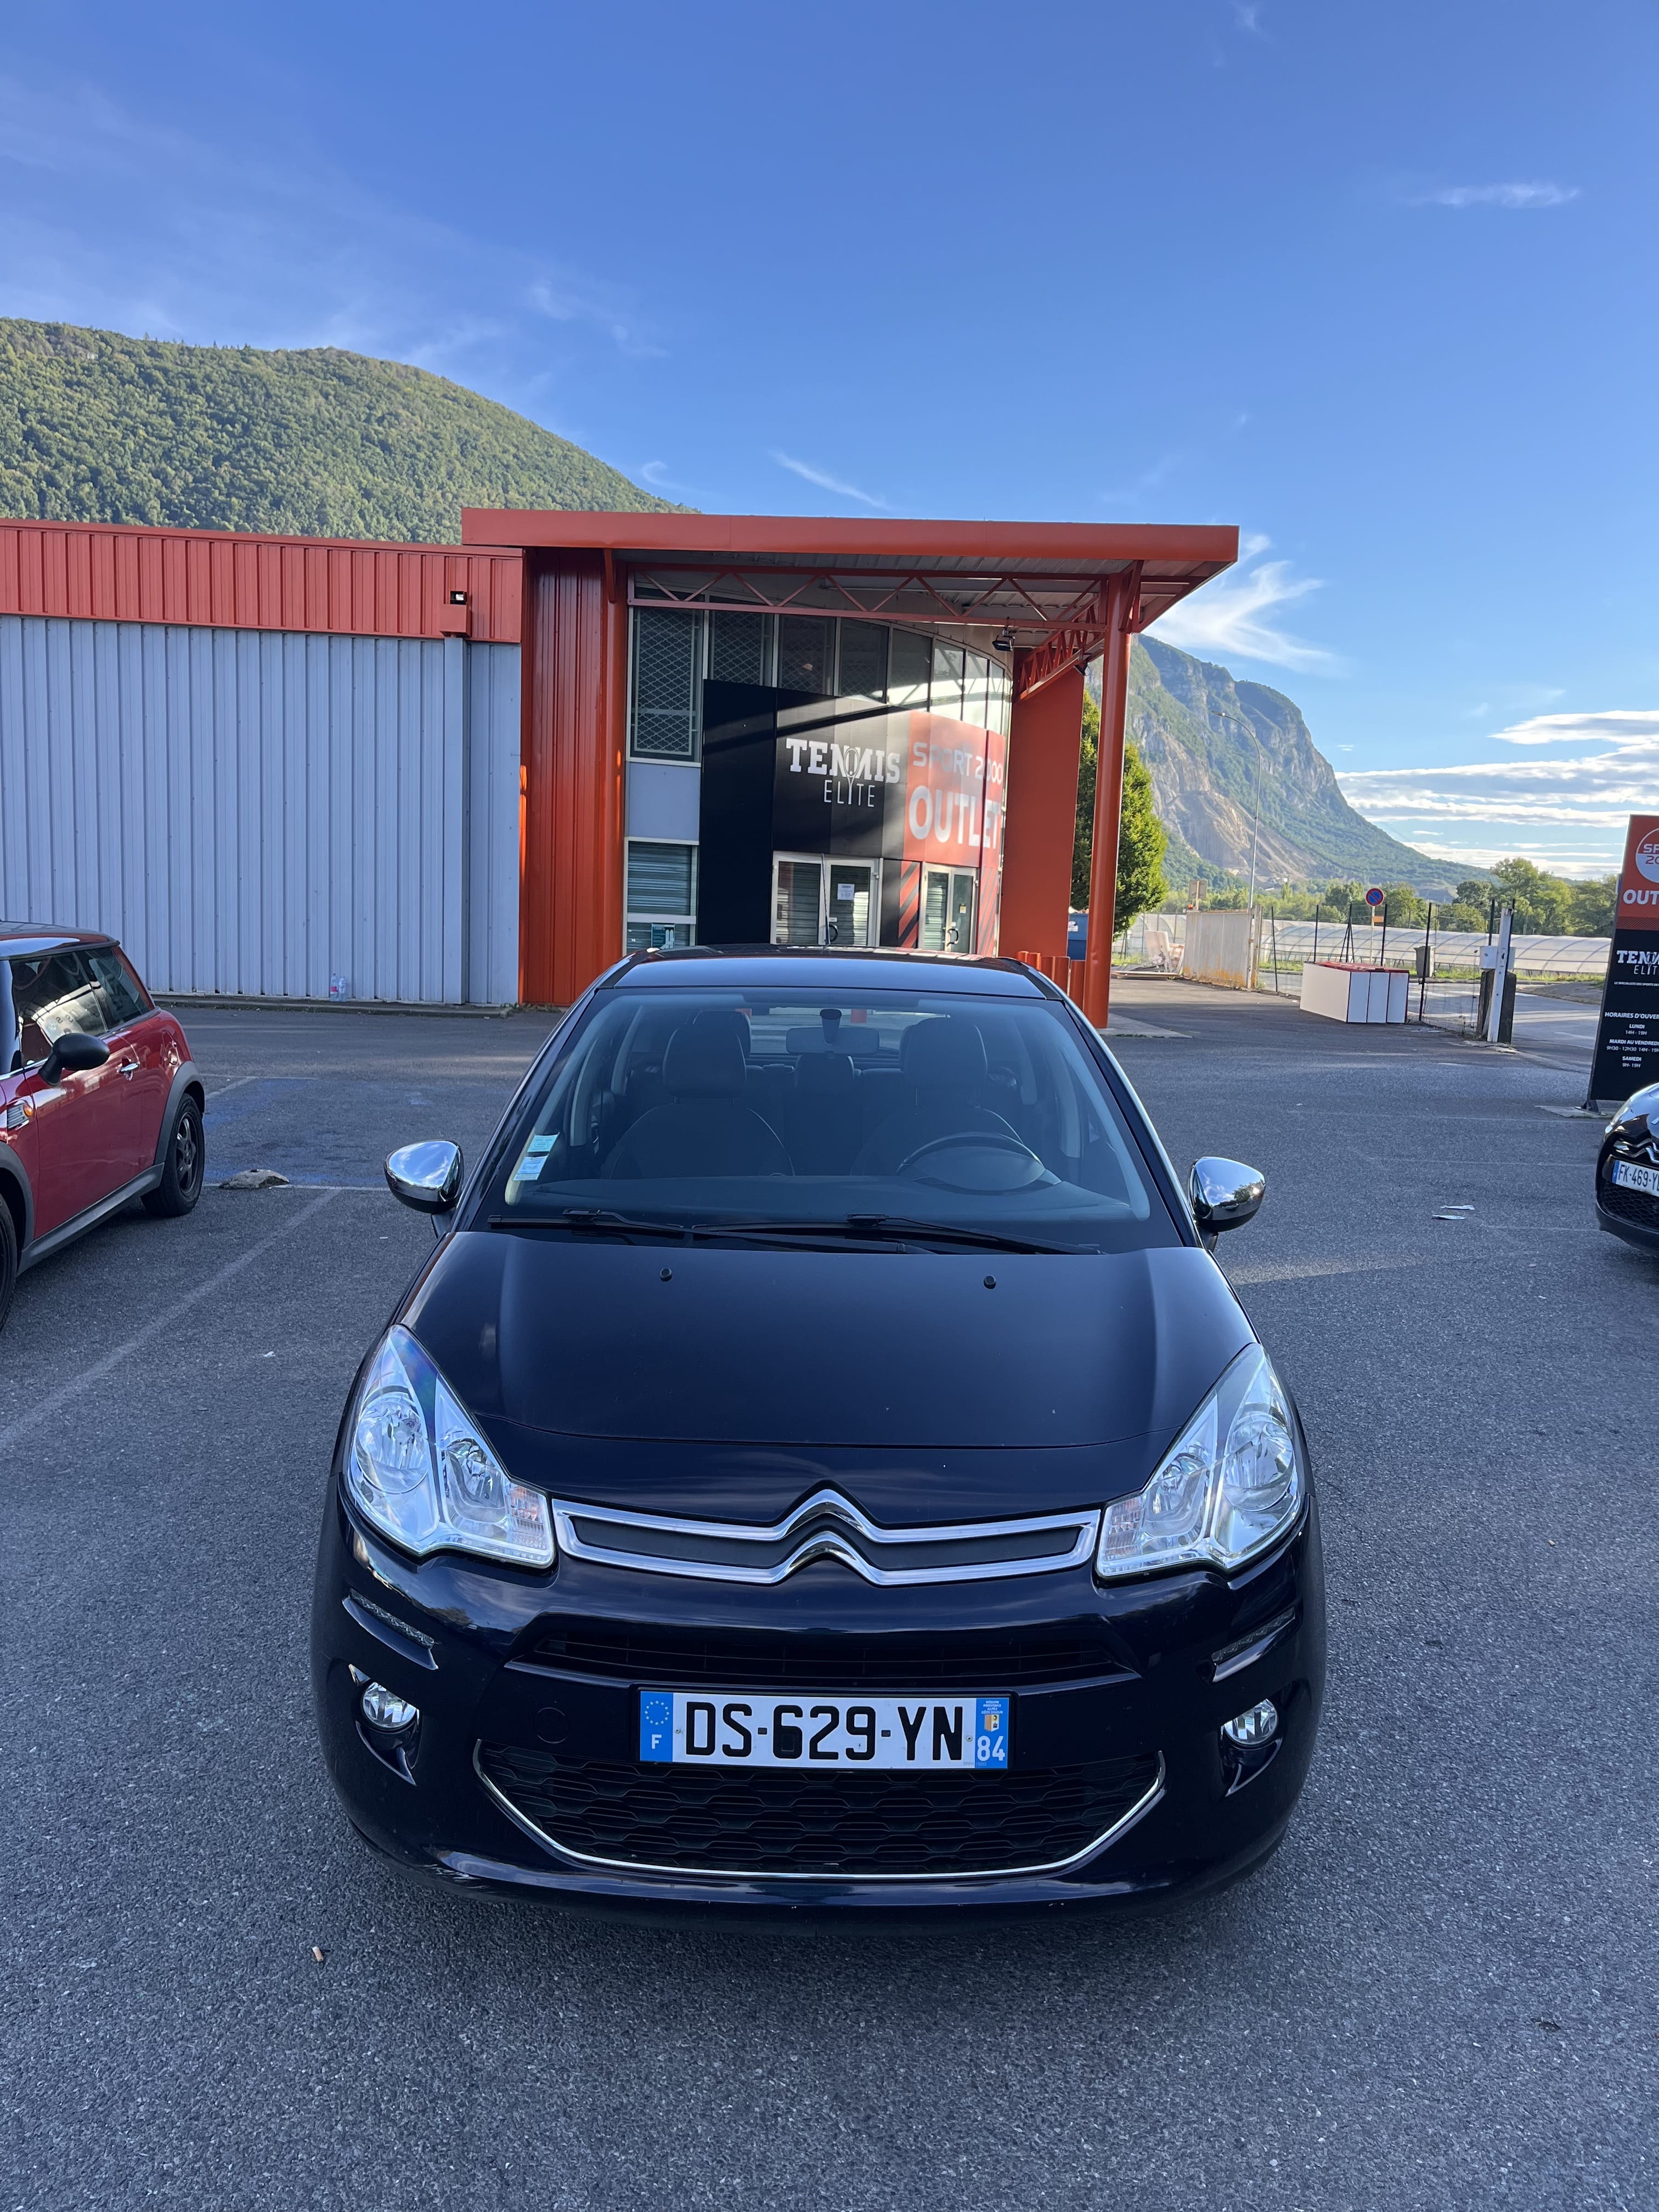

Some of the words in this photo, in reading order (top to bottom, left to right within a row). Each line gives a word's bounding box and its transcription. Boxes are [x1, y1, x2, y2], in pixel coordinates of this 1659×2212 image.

[786, 737, 900, 784] TENNIS
[913, 741, 973, 777] SPORT
[975, 755, 1003, 785] 2000
[824, 780, 876, 807] ELITE
[909, 785, 1001, 849] OUTLET
[1623, 889, 1659, 905] OUT
[652, 1734, 662, 1749] F
[686, 1701, 963, 1761] DS-629-YN
[977, 1735, 1006, 1762] 84
